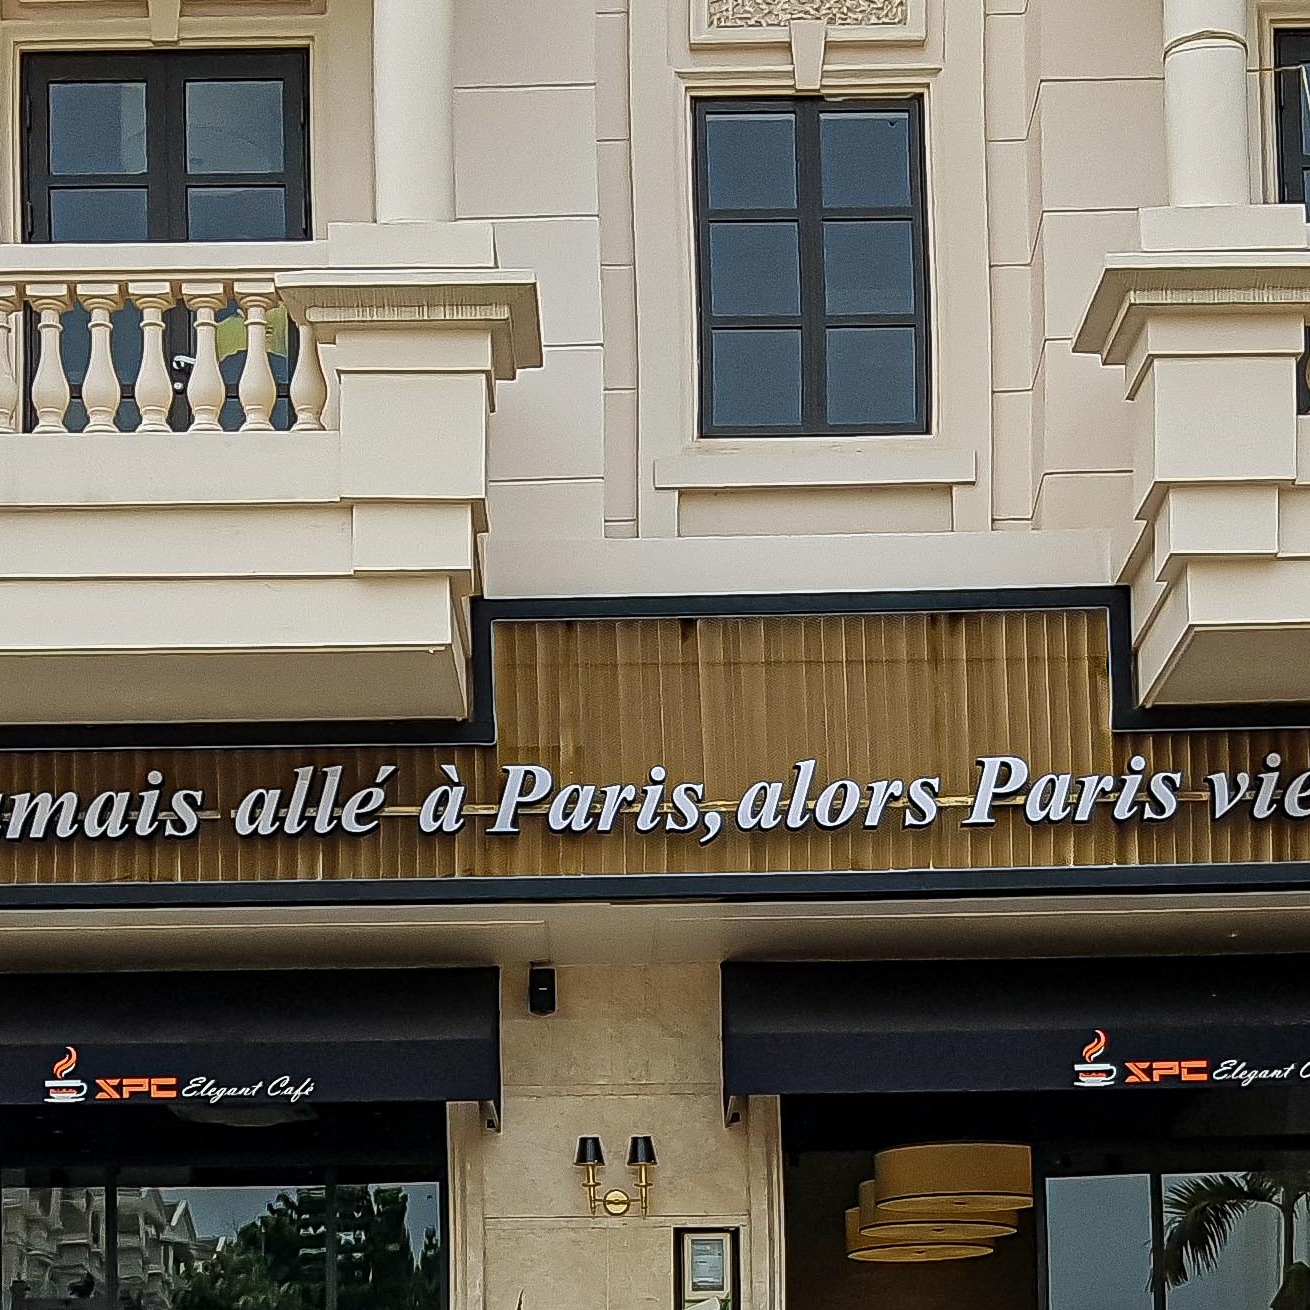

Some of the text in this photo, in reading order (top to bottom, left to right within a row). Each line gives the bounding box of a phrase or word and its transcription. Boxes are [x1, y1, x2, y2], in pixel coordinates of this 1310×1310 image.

[234, 765, 396, 834] allé
[420, 763, 466, 834] à
[736, 758, 940, 830] alors
[961, 754, 1183, 825] Paris
[1212, 1059, 1294, 1087] Elegant
[181, 1076, 264, 1104] Elegant
